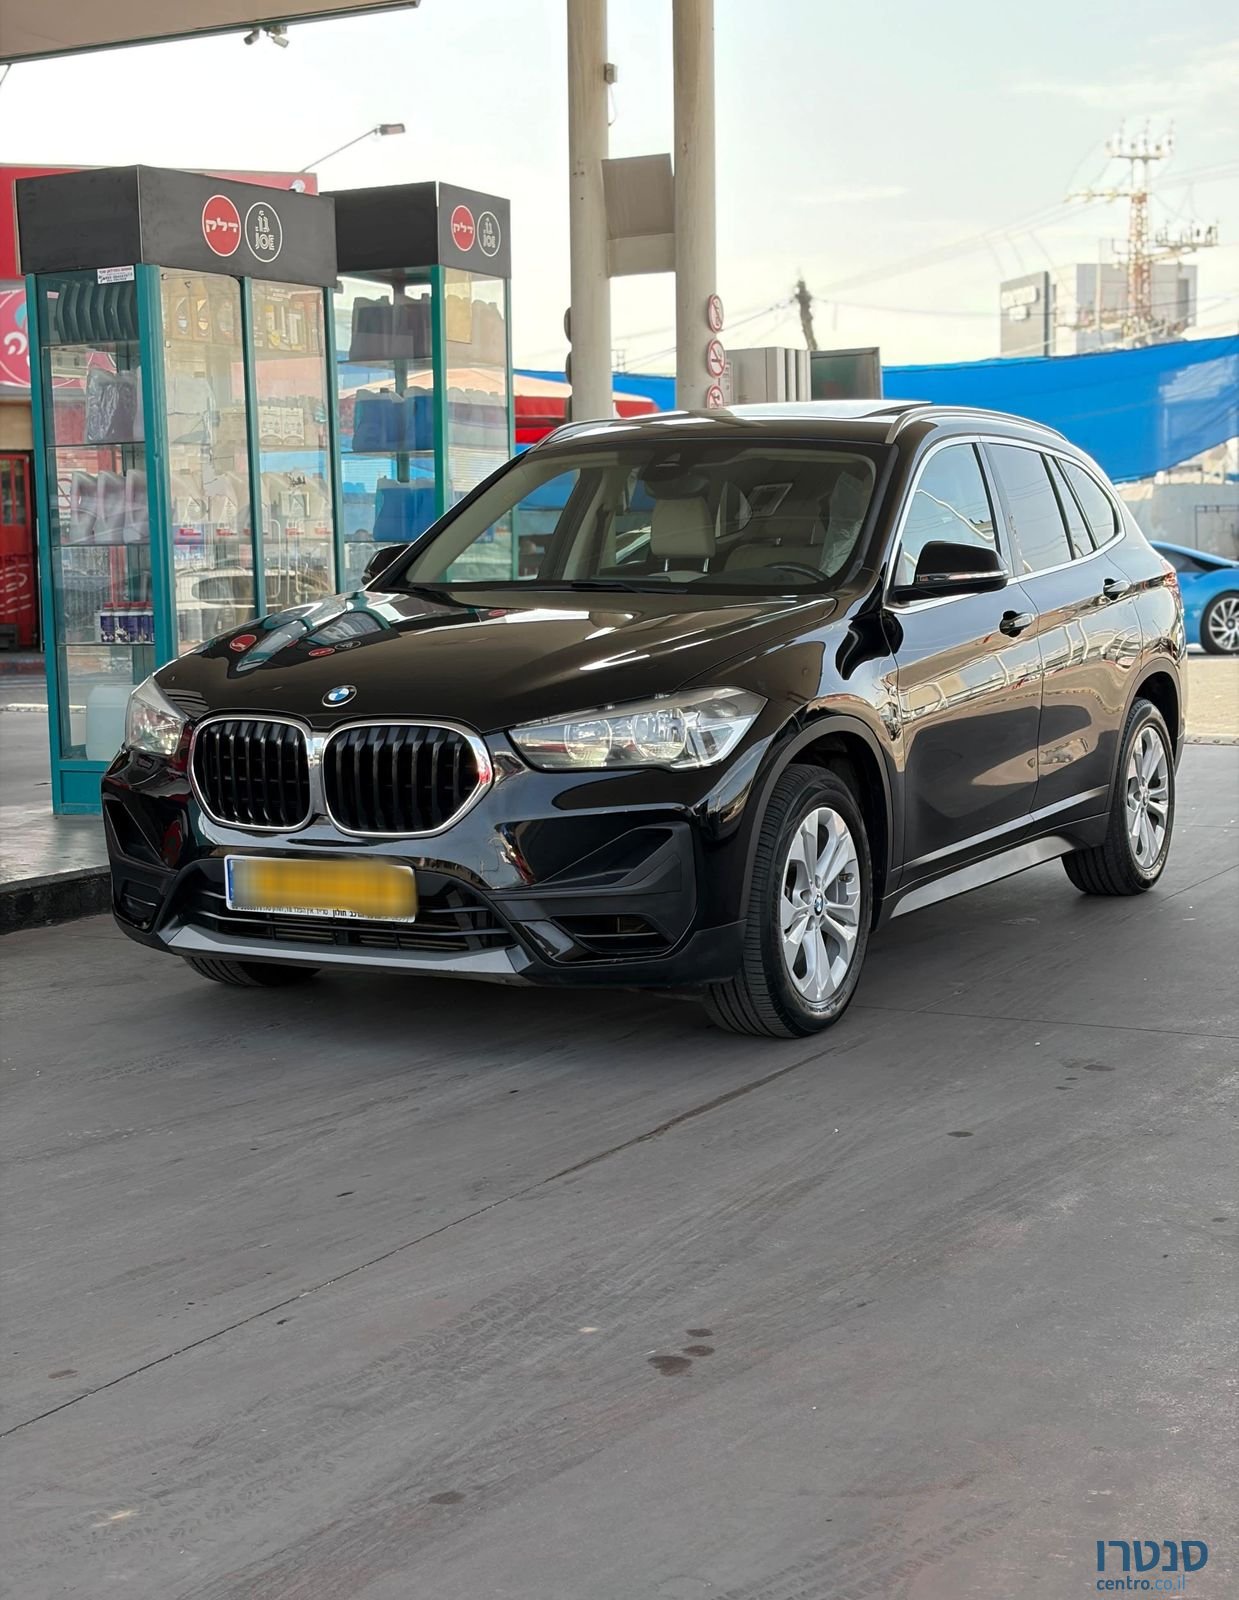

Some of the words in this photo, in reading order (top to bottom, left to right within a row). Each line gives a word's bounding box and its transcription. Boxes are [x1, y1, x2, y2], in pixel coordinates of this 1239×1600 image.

[205, 217, 239, 233] דלק
[453, 222, 474, 234] דלק
[255, 229, 275, 251] JOE
